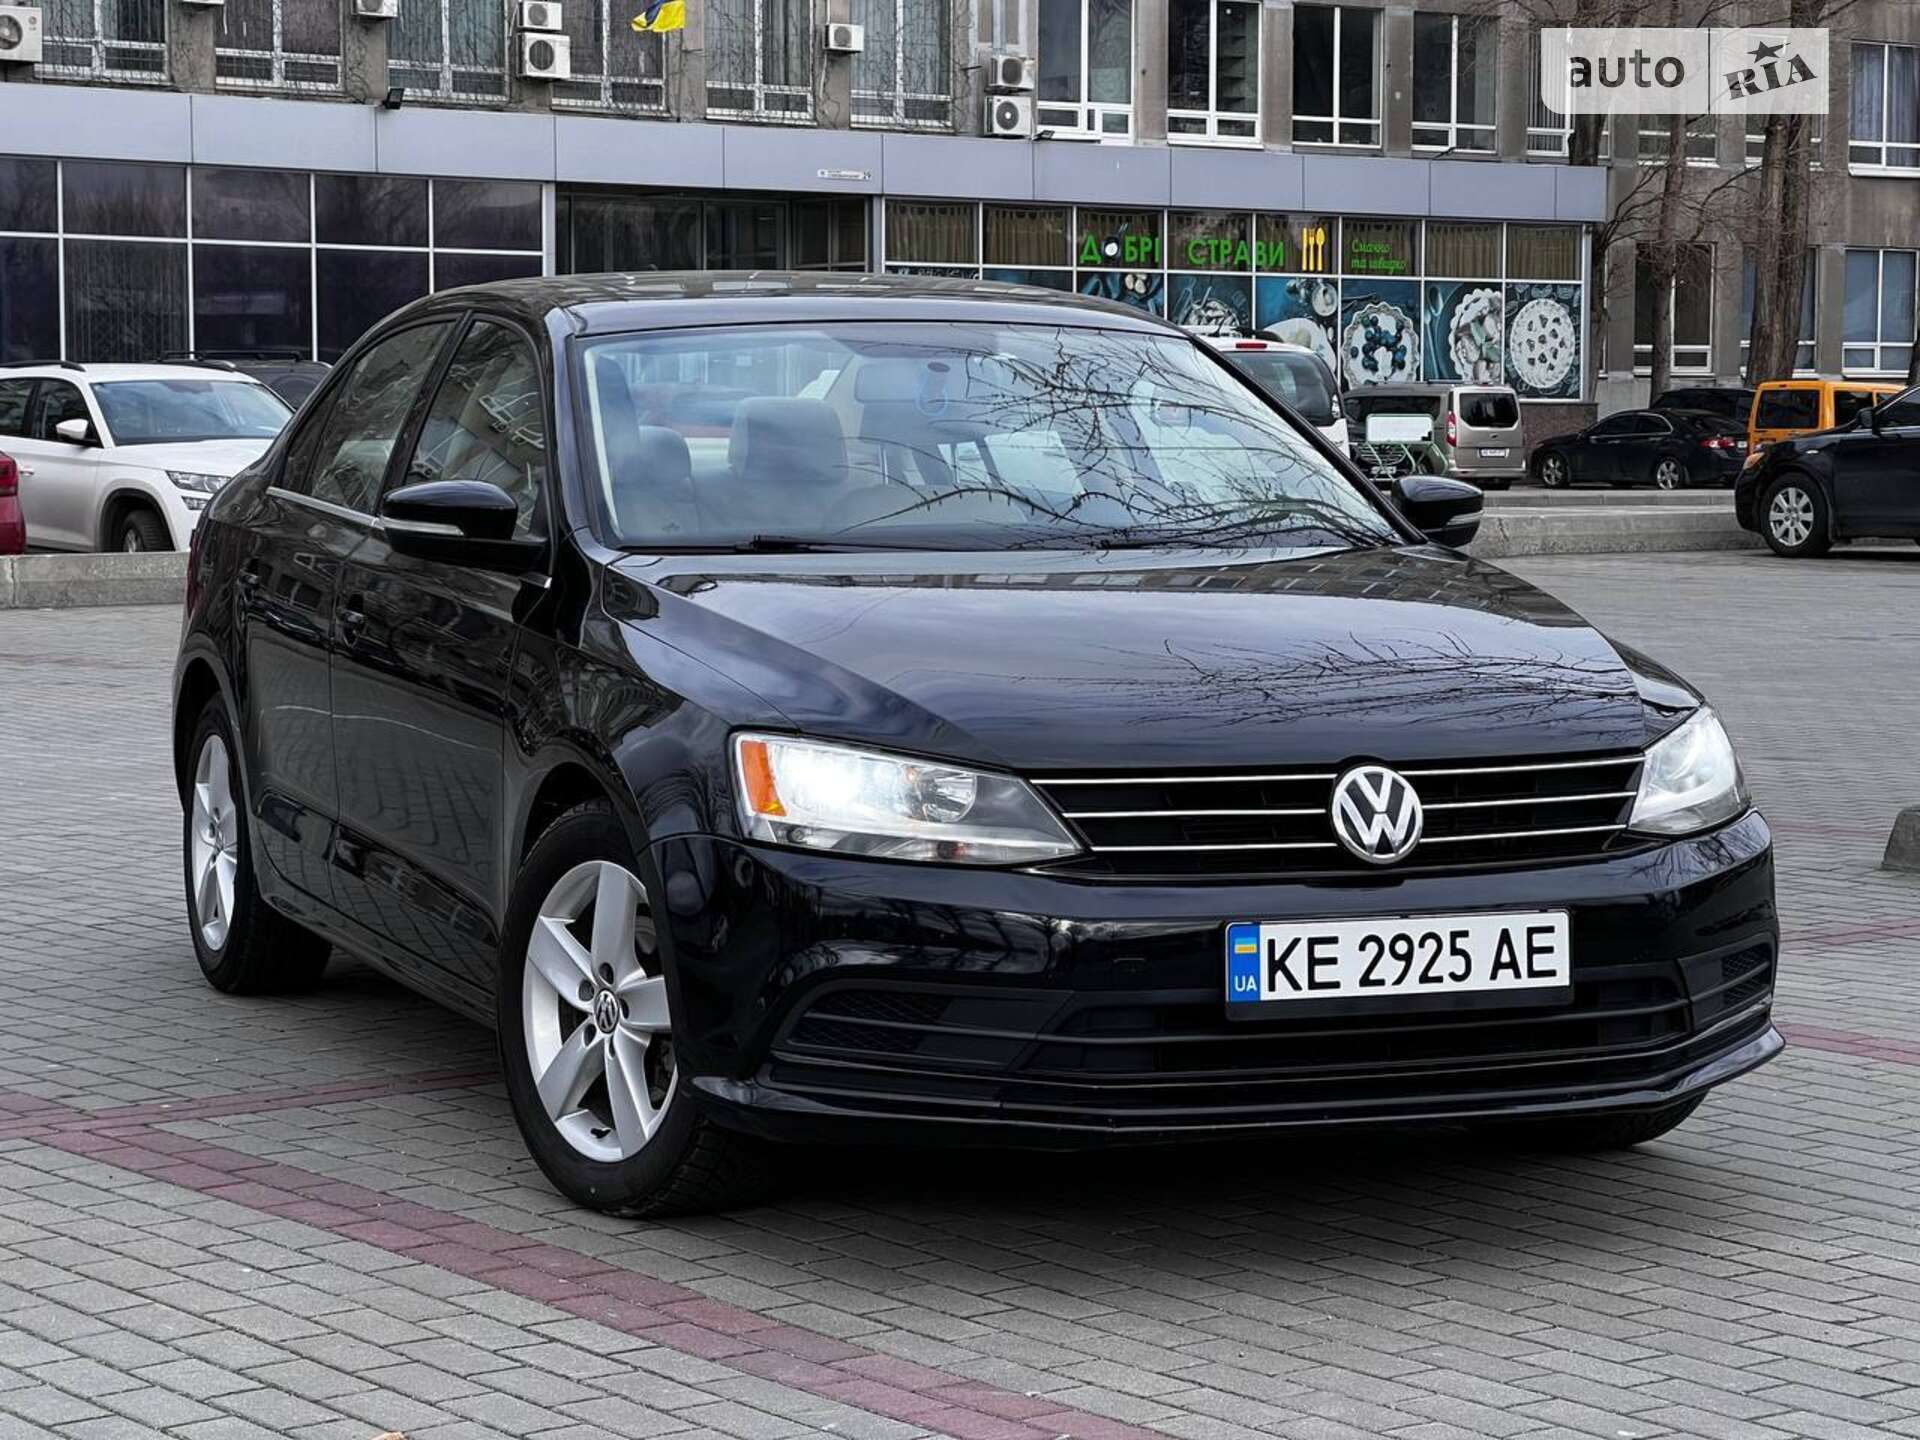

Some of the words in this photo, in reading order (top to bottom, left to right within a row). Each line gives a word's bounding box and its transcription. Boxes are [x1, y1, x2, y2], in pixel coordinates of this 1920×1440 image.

[1187, 239, 1285, 267] СТРАВИ
[1266, 935, 1342, 993] KE
[1357, 929, 1473, 989] 2925
[1488, 925, 1559, 982] AE
[1234, 975, 1258, 992] UA
